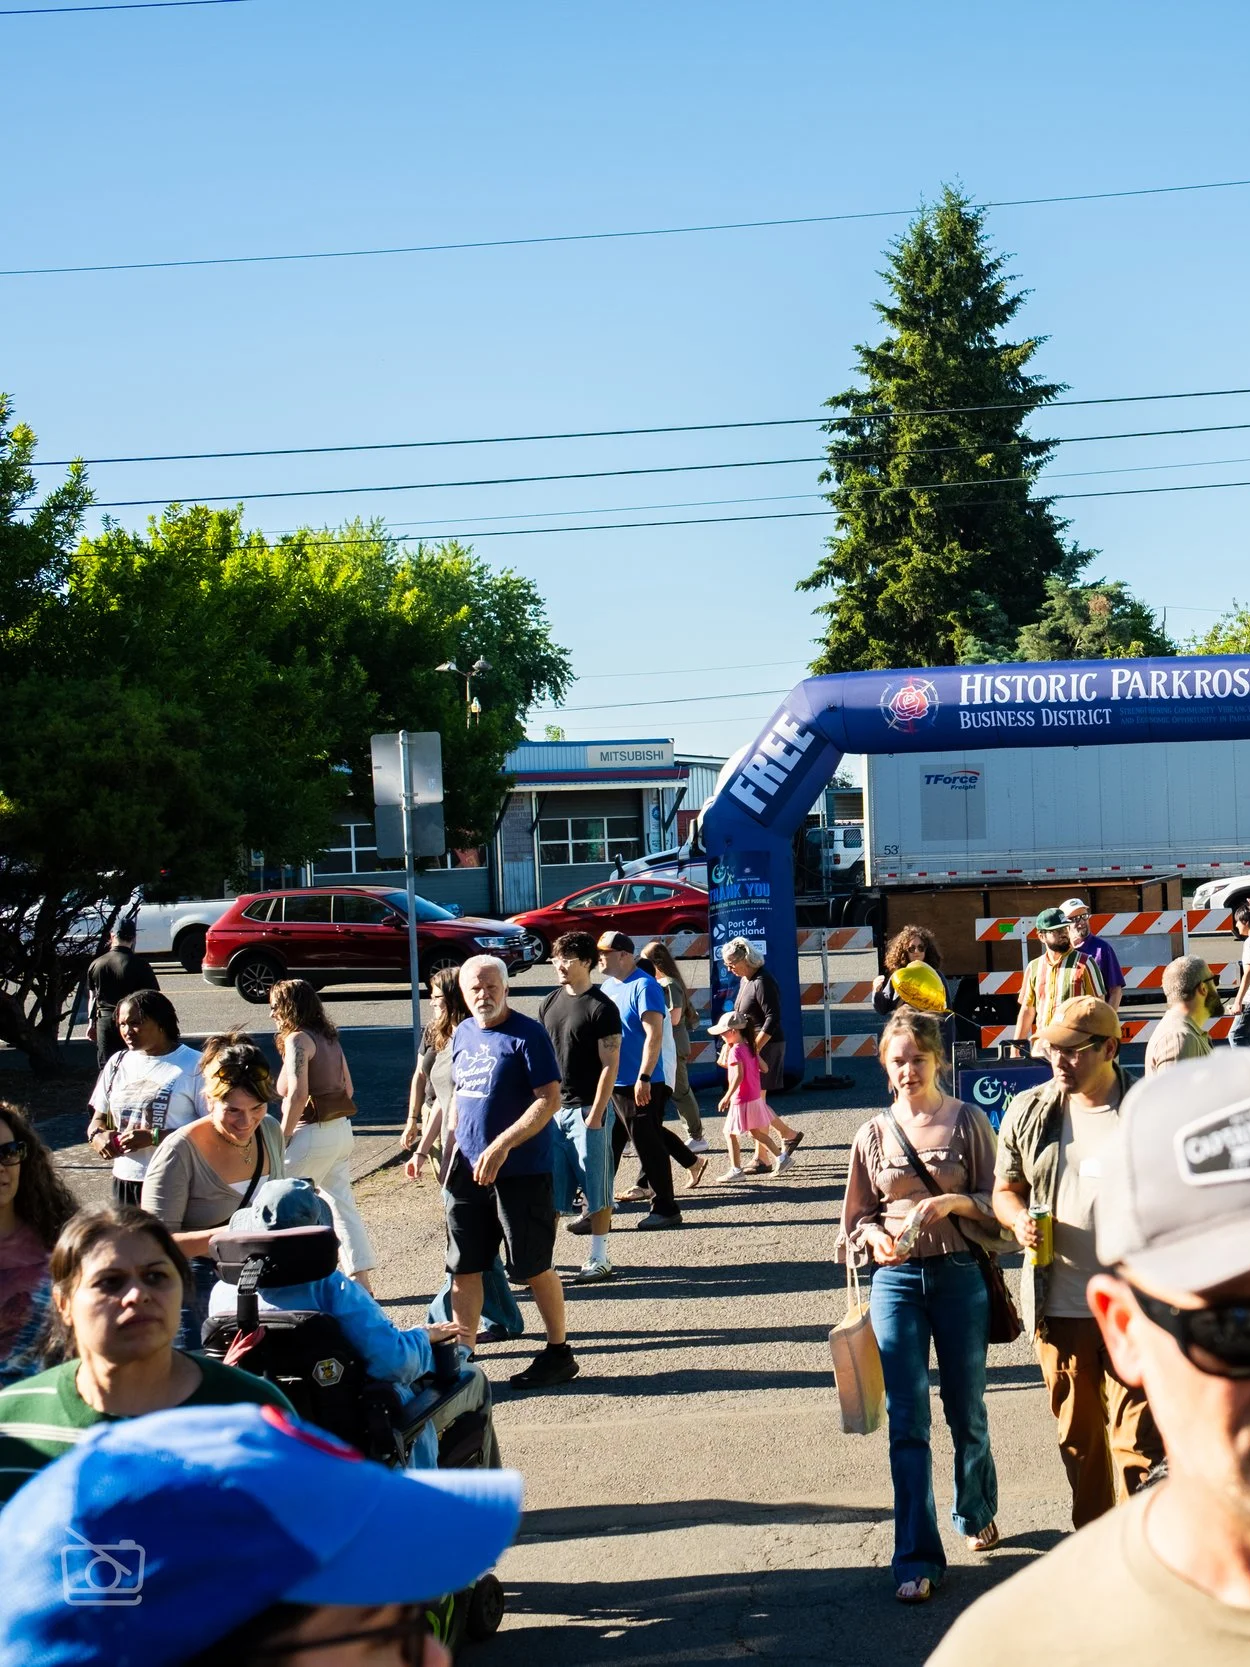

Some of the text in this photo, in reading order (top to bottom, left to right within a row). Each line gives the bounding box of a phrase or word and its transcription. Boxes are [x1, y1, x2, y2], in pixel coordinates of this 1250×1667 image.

[959, 672, 1098, 706] HISTORIC
[958, 707, 1113, 729] BUSINESS DISTRICT
[600, 751, 664, 762] MITSUBISHI
[729, 713, 816, 815] FREE
[924, 774, 979, 785] TForce
[709, 882, 771, 903] THANK YOU
[728, 917, 757, 929] Port of
[728, 926, 766, 938] Portland
[152, 1103, 169, 1128] BUSC
